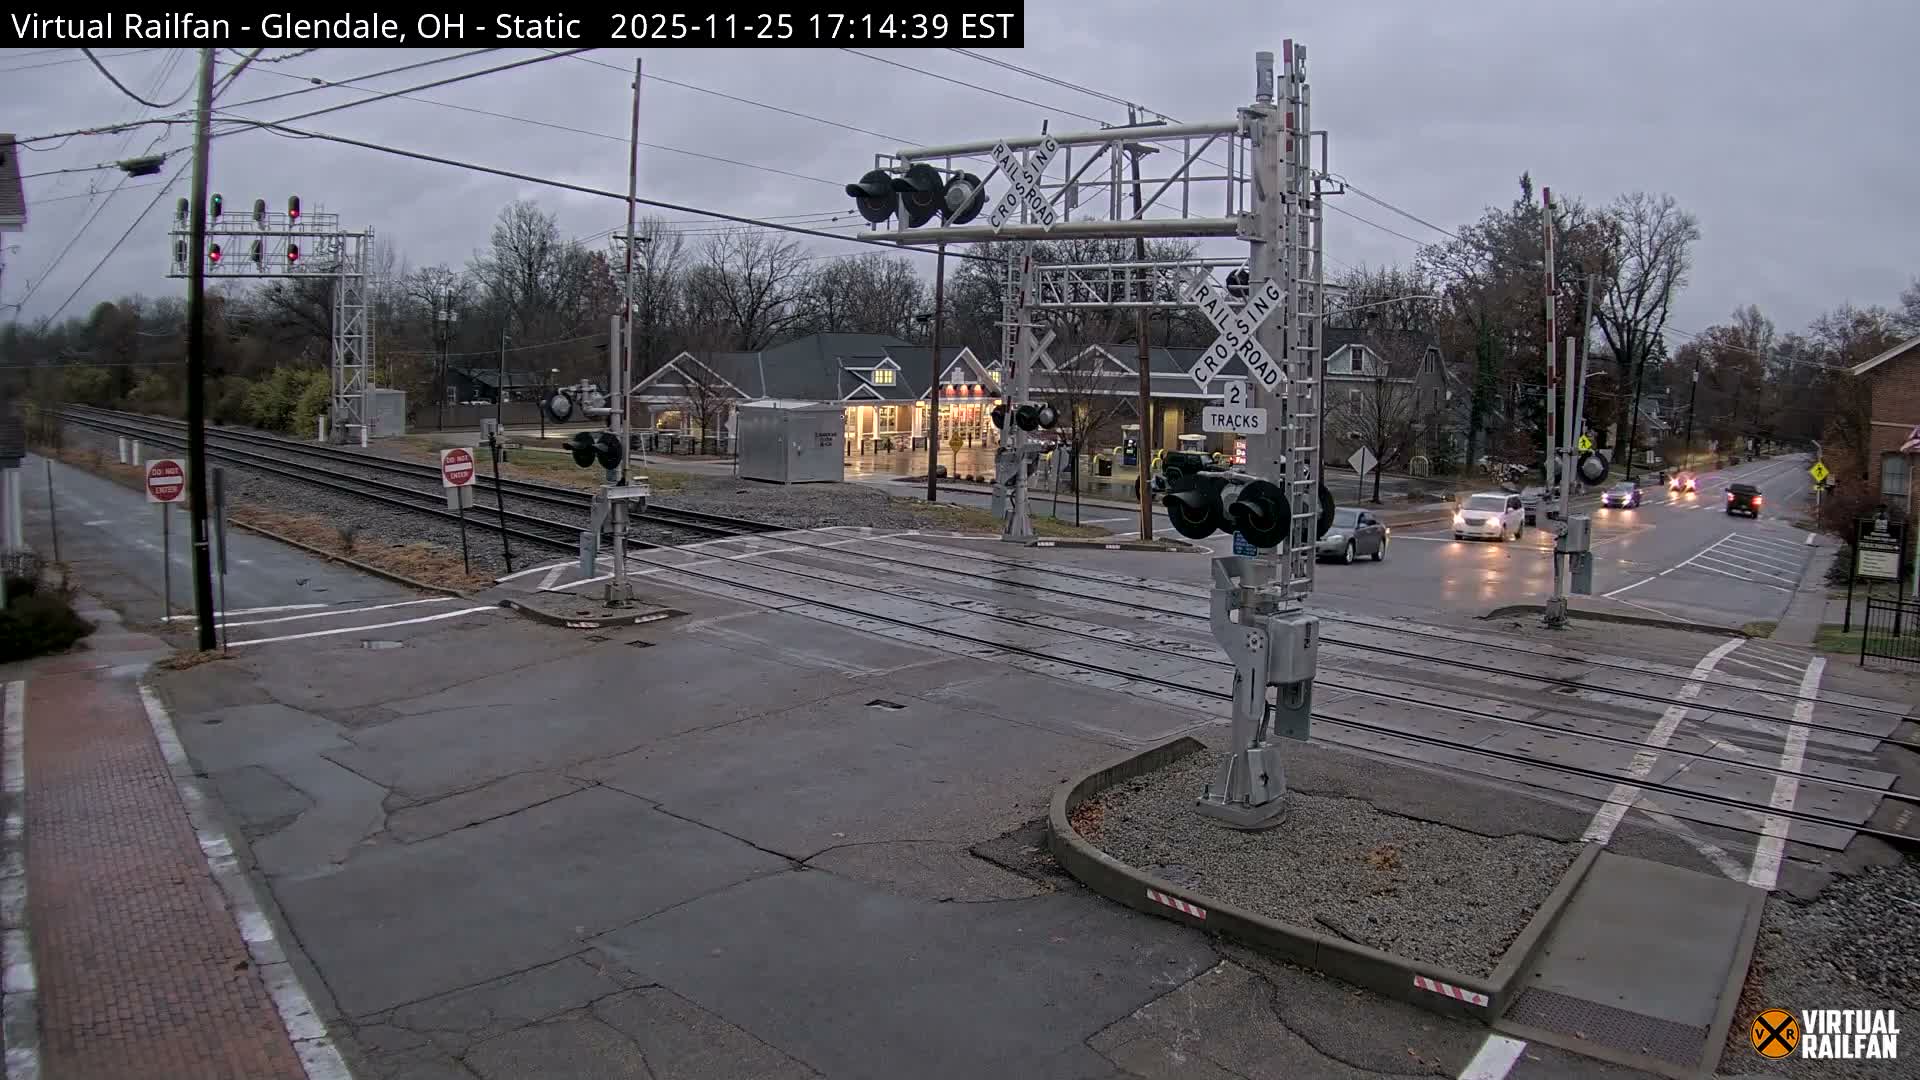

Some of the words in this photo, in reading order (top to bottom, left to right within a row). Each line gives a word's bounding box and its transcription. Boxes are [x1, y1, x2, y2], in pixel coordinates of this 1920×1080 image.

[990, 139, 1056, 228] CROSSING
[1193, 284, 1281, 384] CROSSING
[1211, 412, 1259, 429] TRACKS
[1230, 386, 1241, 404] 2
